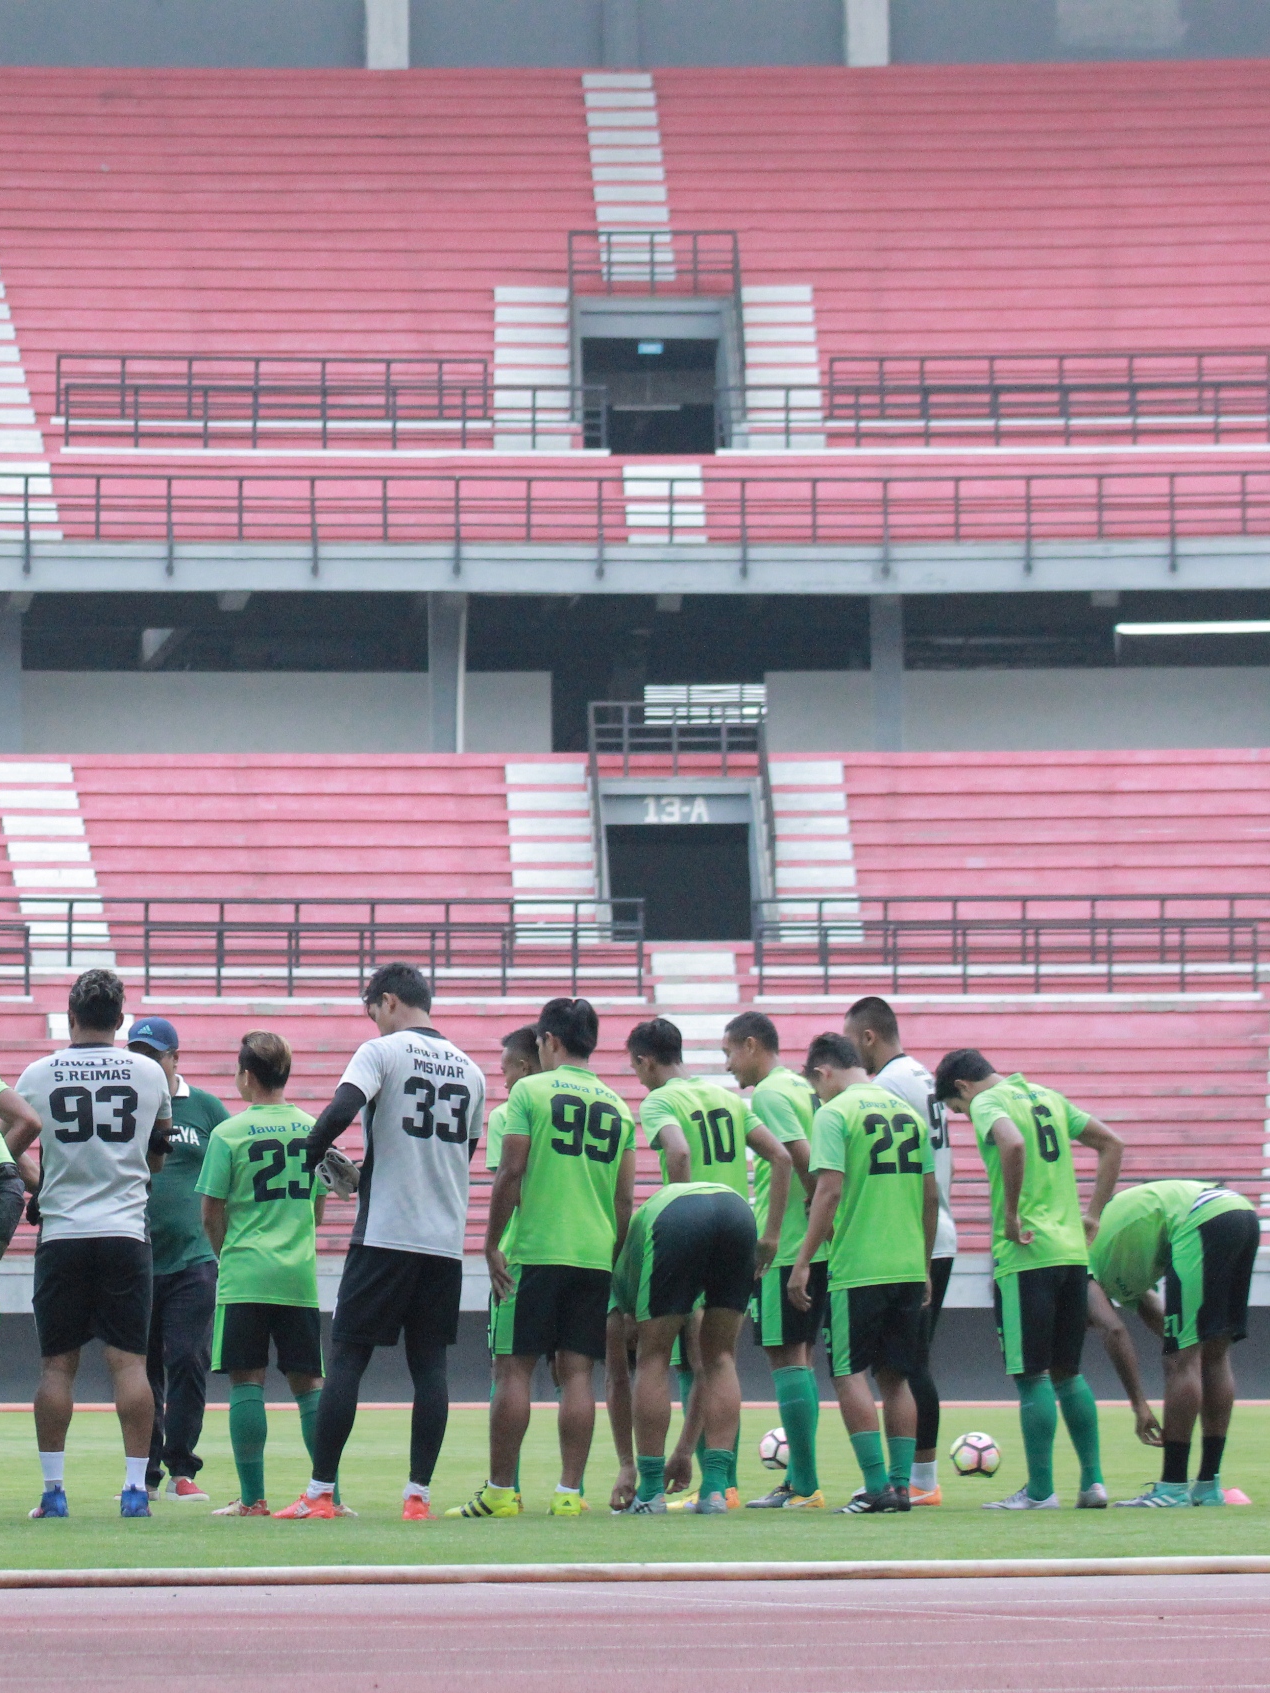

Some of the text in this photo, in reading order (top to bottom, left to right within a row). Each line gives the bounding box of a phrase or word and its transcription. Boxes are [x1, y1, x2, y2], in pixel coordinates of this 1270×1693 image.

[643, 796, 709, 823] 13-A
[49, 1058, 134, 1067] Jawa Pos
[54, 1068, 131, 1082] S.REIMAS
[406, 1043, 470, 1066] Jawa Pos
[413, 1058, 465, 1080] MISWAR
[402, 1076, 470, 1144] 33
[551, 1079, 618, 1103] Jawa Pos
[49, 1085, 138, 1143] 93
[247, 1125, 287, 1136] Jawa
[550, 1093, 622, 1164] 99
[1031, 1104, 1061, 1163] 6
[690, 1107, 736, 1165] 10
[863, 1113, 922, 1175] 22
[248, 1138, 316, 1202] 23
